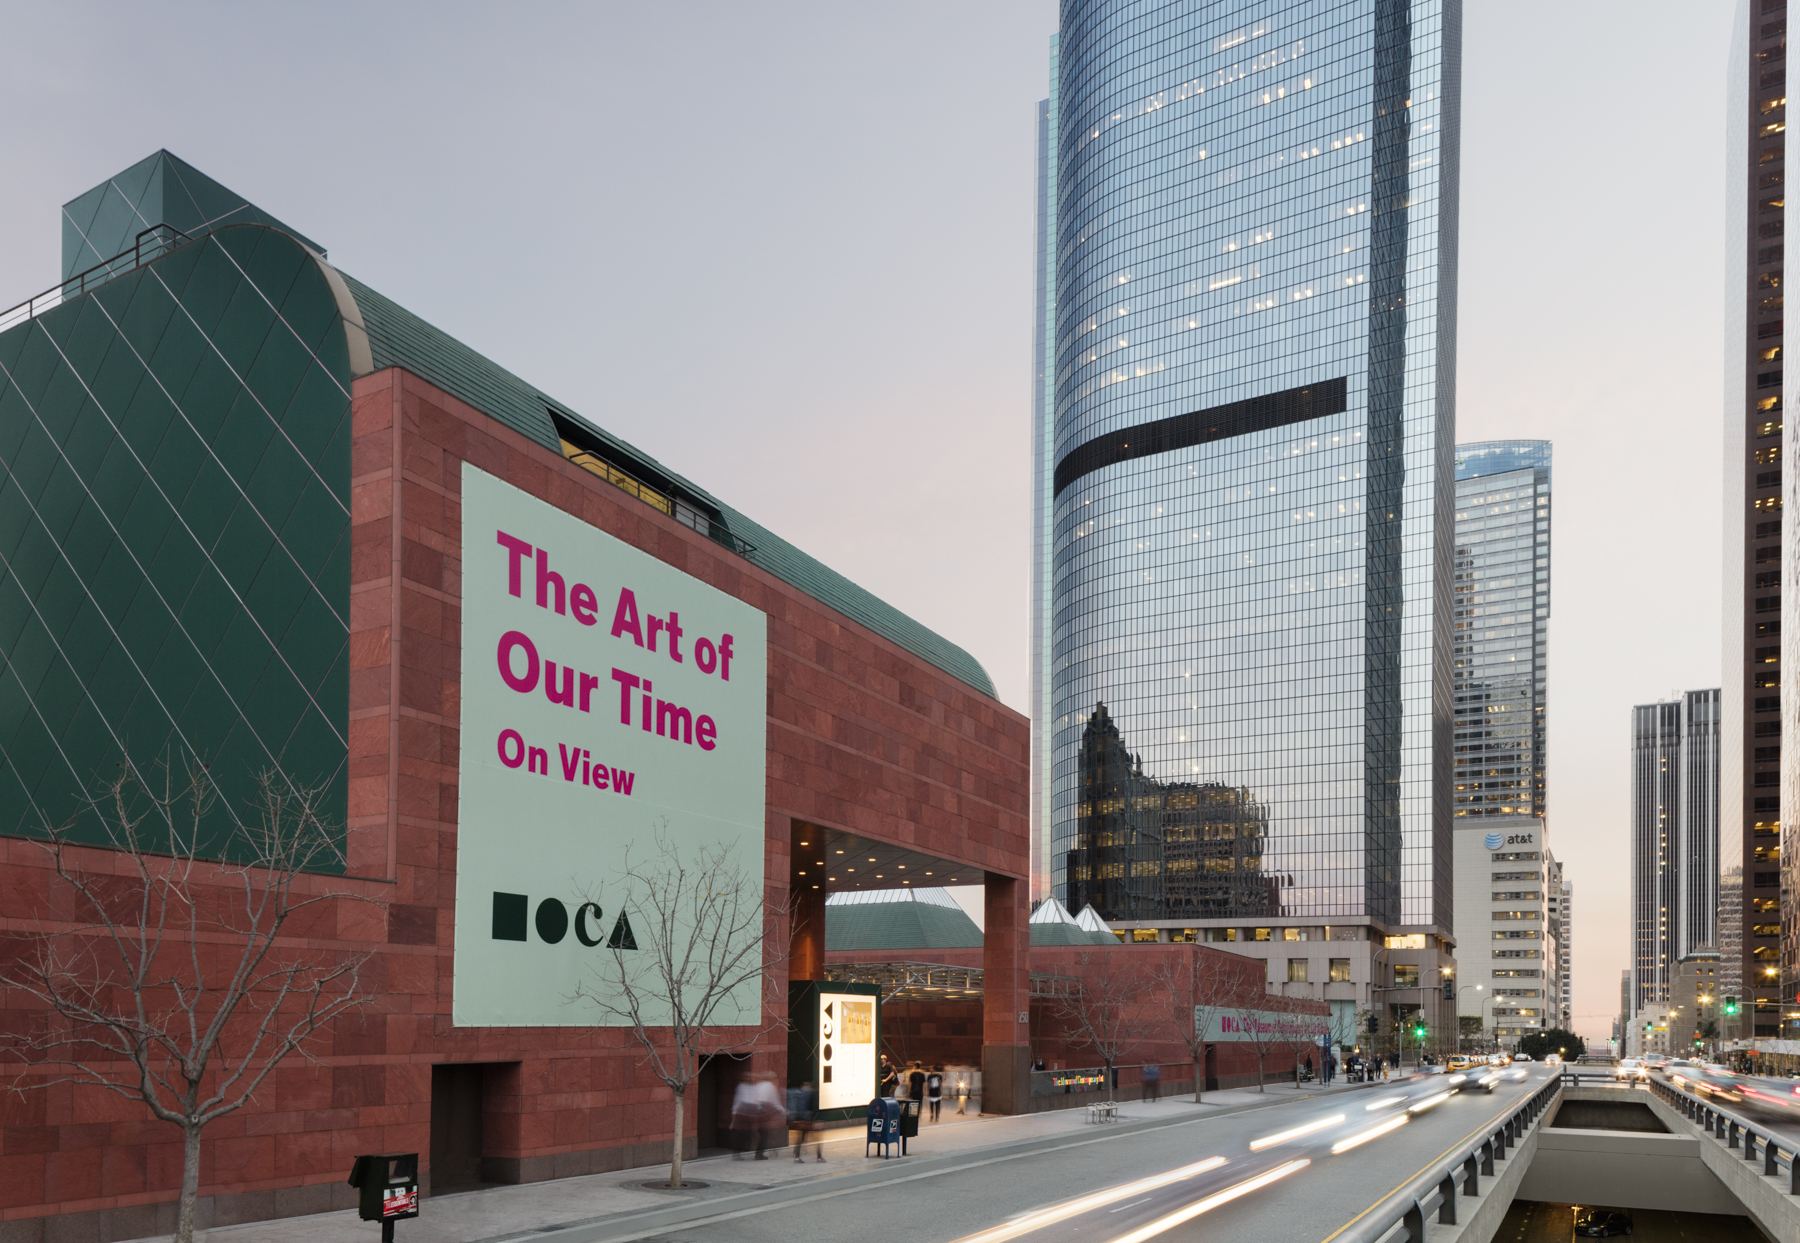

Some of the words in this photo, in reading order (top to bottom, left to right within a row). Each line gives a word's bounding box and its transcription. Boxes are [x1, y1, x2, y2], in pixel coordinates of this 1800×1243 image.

[497, 530, 598, 626] The
[611, 587, 682, 663] Art
[695, 634, 733, 681] of
[498, 631, 598, 713] Our
[612, 668, 716, 751] Time
[498, 729, 547, 775] On
[559, 743, 635, 795] View
[1507, 833, 1533, 844] at&t
